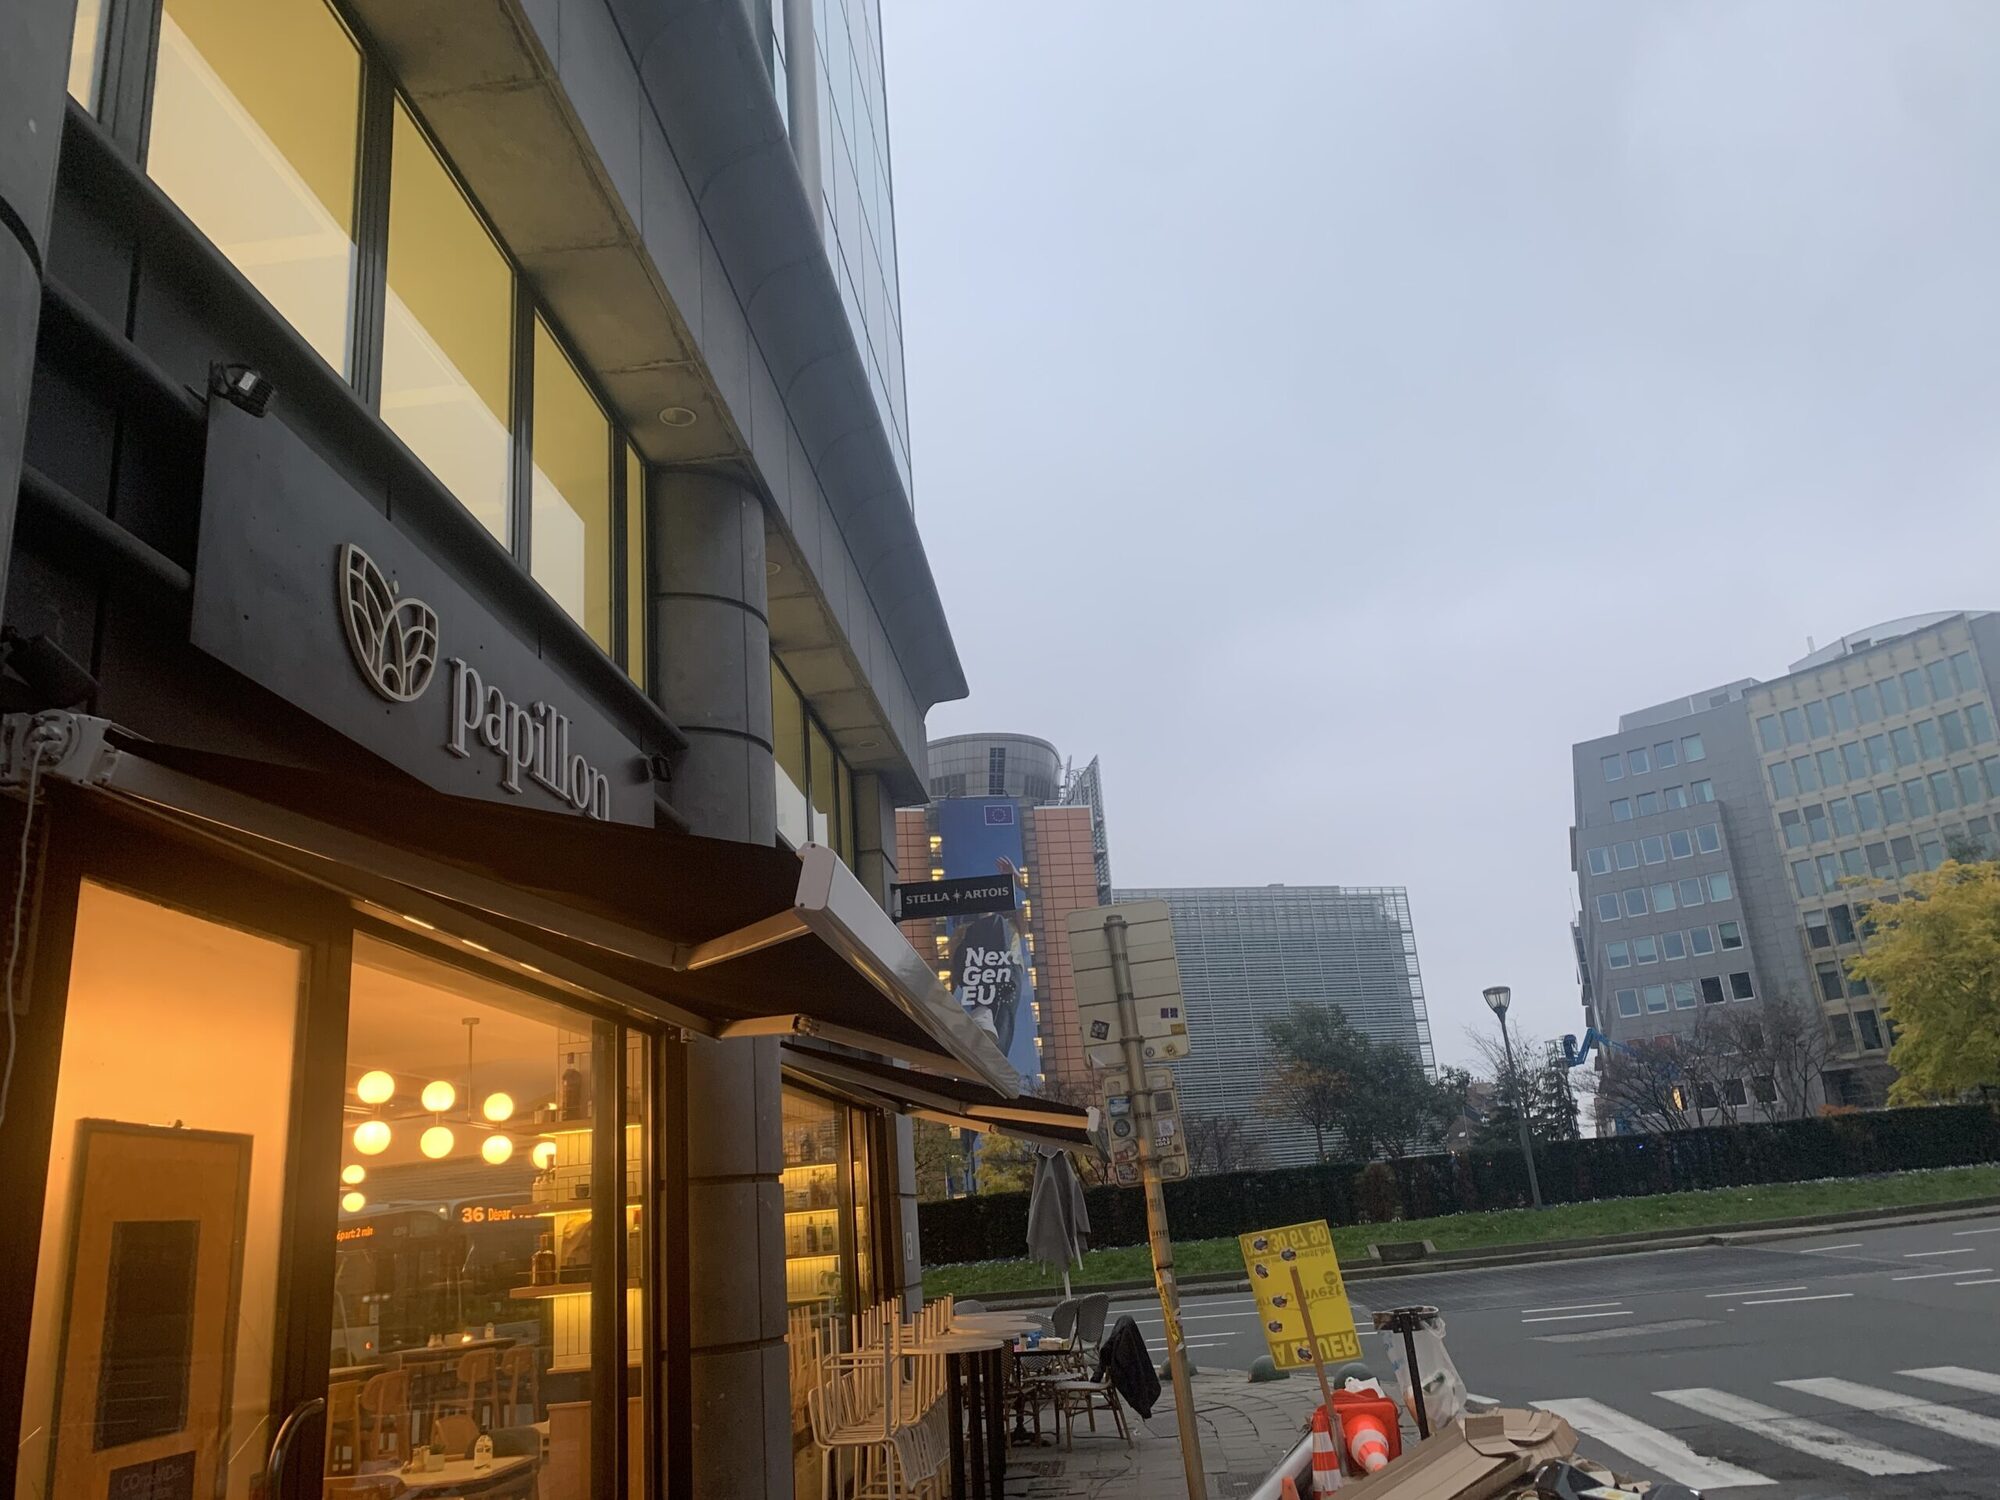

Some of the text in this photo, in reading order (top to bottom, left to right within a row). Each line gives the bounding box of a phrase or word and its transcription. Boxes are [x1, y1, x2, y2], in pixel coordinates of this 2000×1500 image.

[448, 656, 610, 822] papillon
[906, 886, 1009, 905] STELLA ARTOIS
[965, 947, 1022, 967] Next
[963, 965, 1011, 986] Gen
[961, 985, 996, 1006] EU
[461, 1206, 485, 1223] 36
